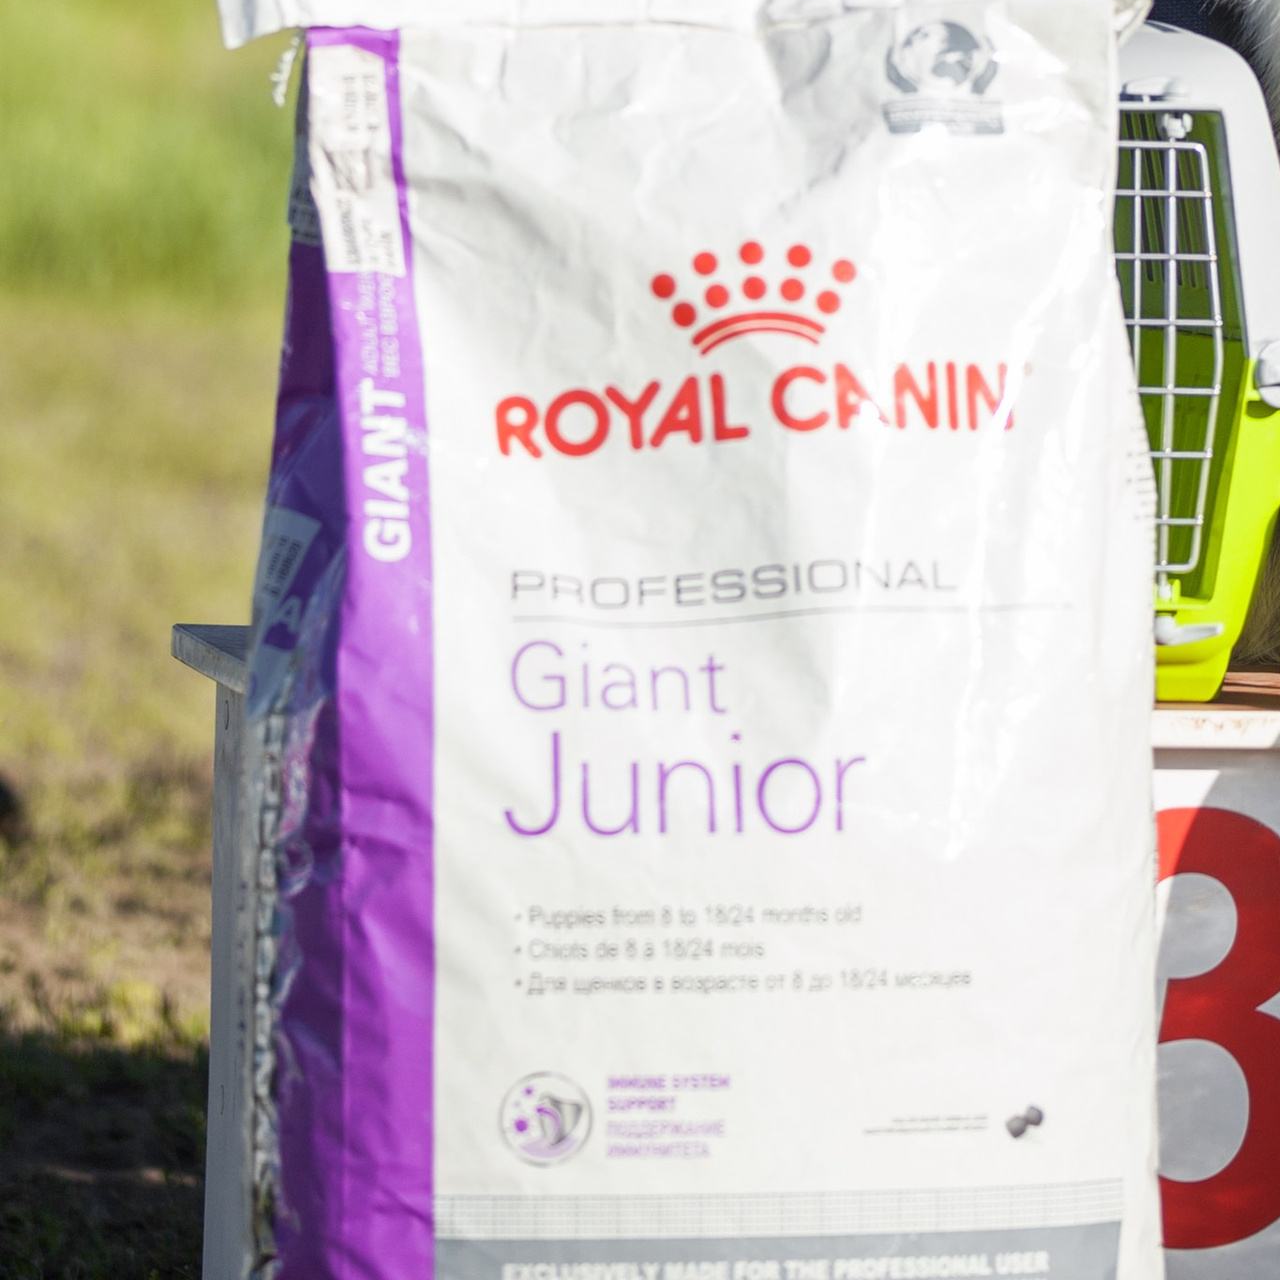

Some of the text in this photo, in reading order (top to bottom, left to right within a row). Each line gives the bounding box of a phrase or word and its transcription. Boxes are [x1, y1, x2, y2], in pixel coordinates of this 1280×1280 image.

[495, 359, 1016, 459] ROYAL CANIN
[360, 377, 412, 563] GIANT
[510, 559, 958, 610] PROFESSIONAL
[510, 640, 728, 714] Giant
[505, 731, 866, 837] Junior
[529, 905, 606, 930] Puppies
[612, 905, 655, 926] from
[679, 906, 696, 926] to
[762, 905, 829, 924] months
[834, 903, 863, 924] old
[528, 938, 588, 959] Chiots
[596, 938, 618, 958] de
[721, 940, 765, 959] mois
[527, 971, 567, 995] Для
[672, 975, 760, 994] возрасте
[765, 973, 786, 990] от
[809, 973, 832, 993] до
[895, 970, 973, 990] месяцев
[672, 1073, 730, 1091] SYSTEM
[607, 1096, 677, 1113] SUPPORT
[502, 1250, 1050, 1280] EXCLUSIVELY MADE FOR THE PROFESSIONAL USER
